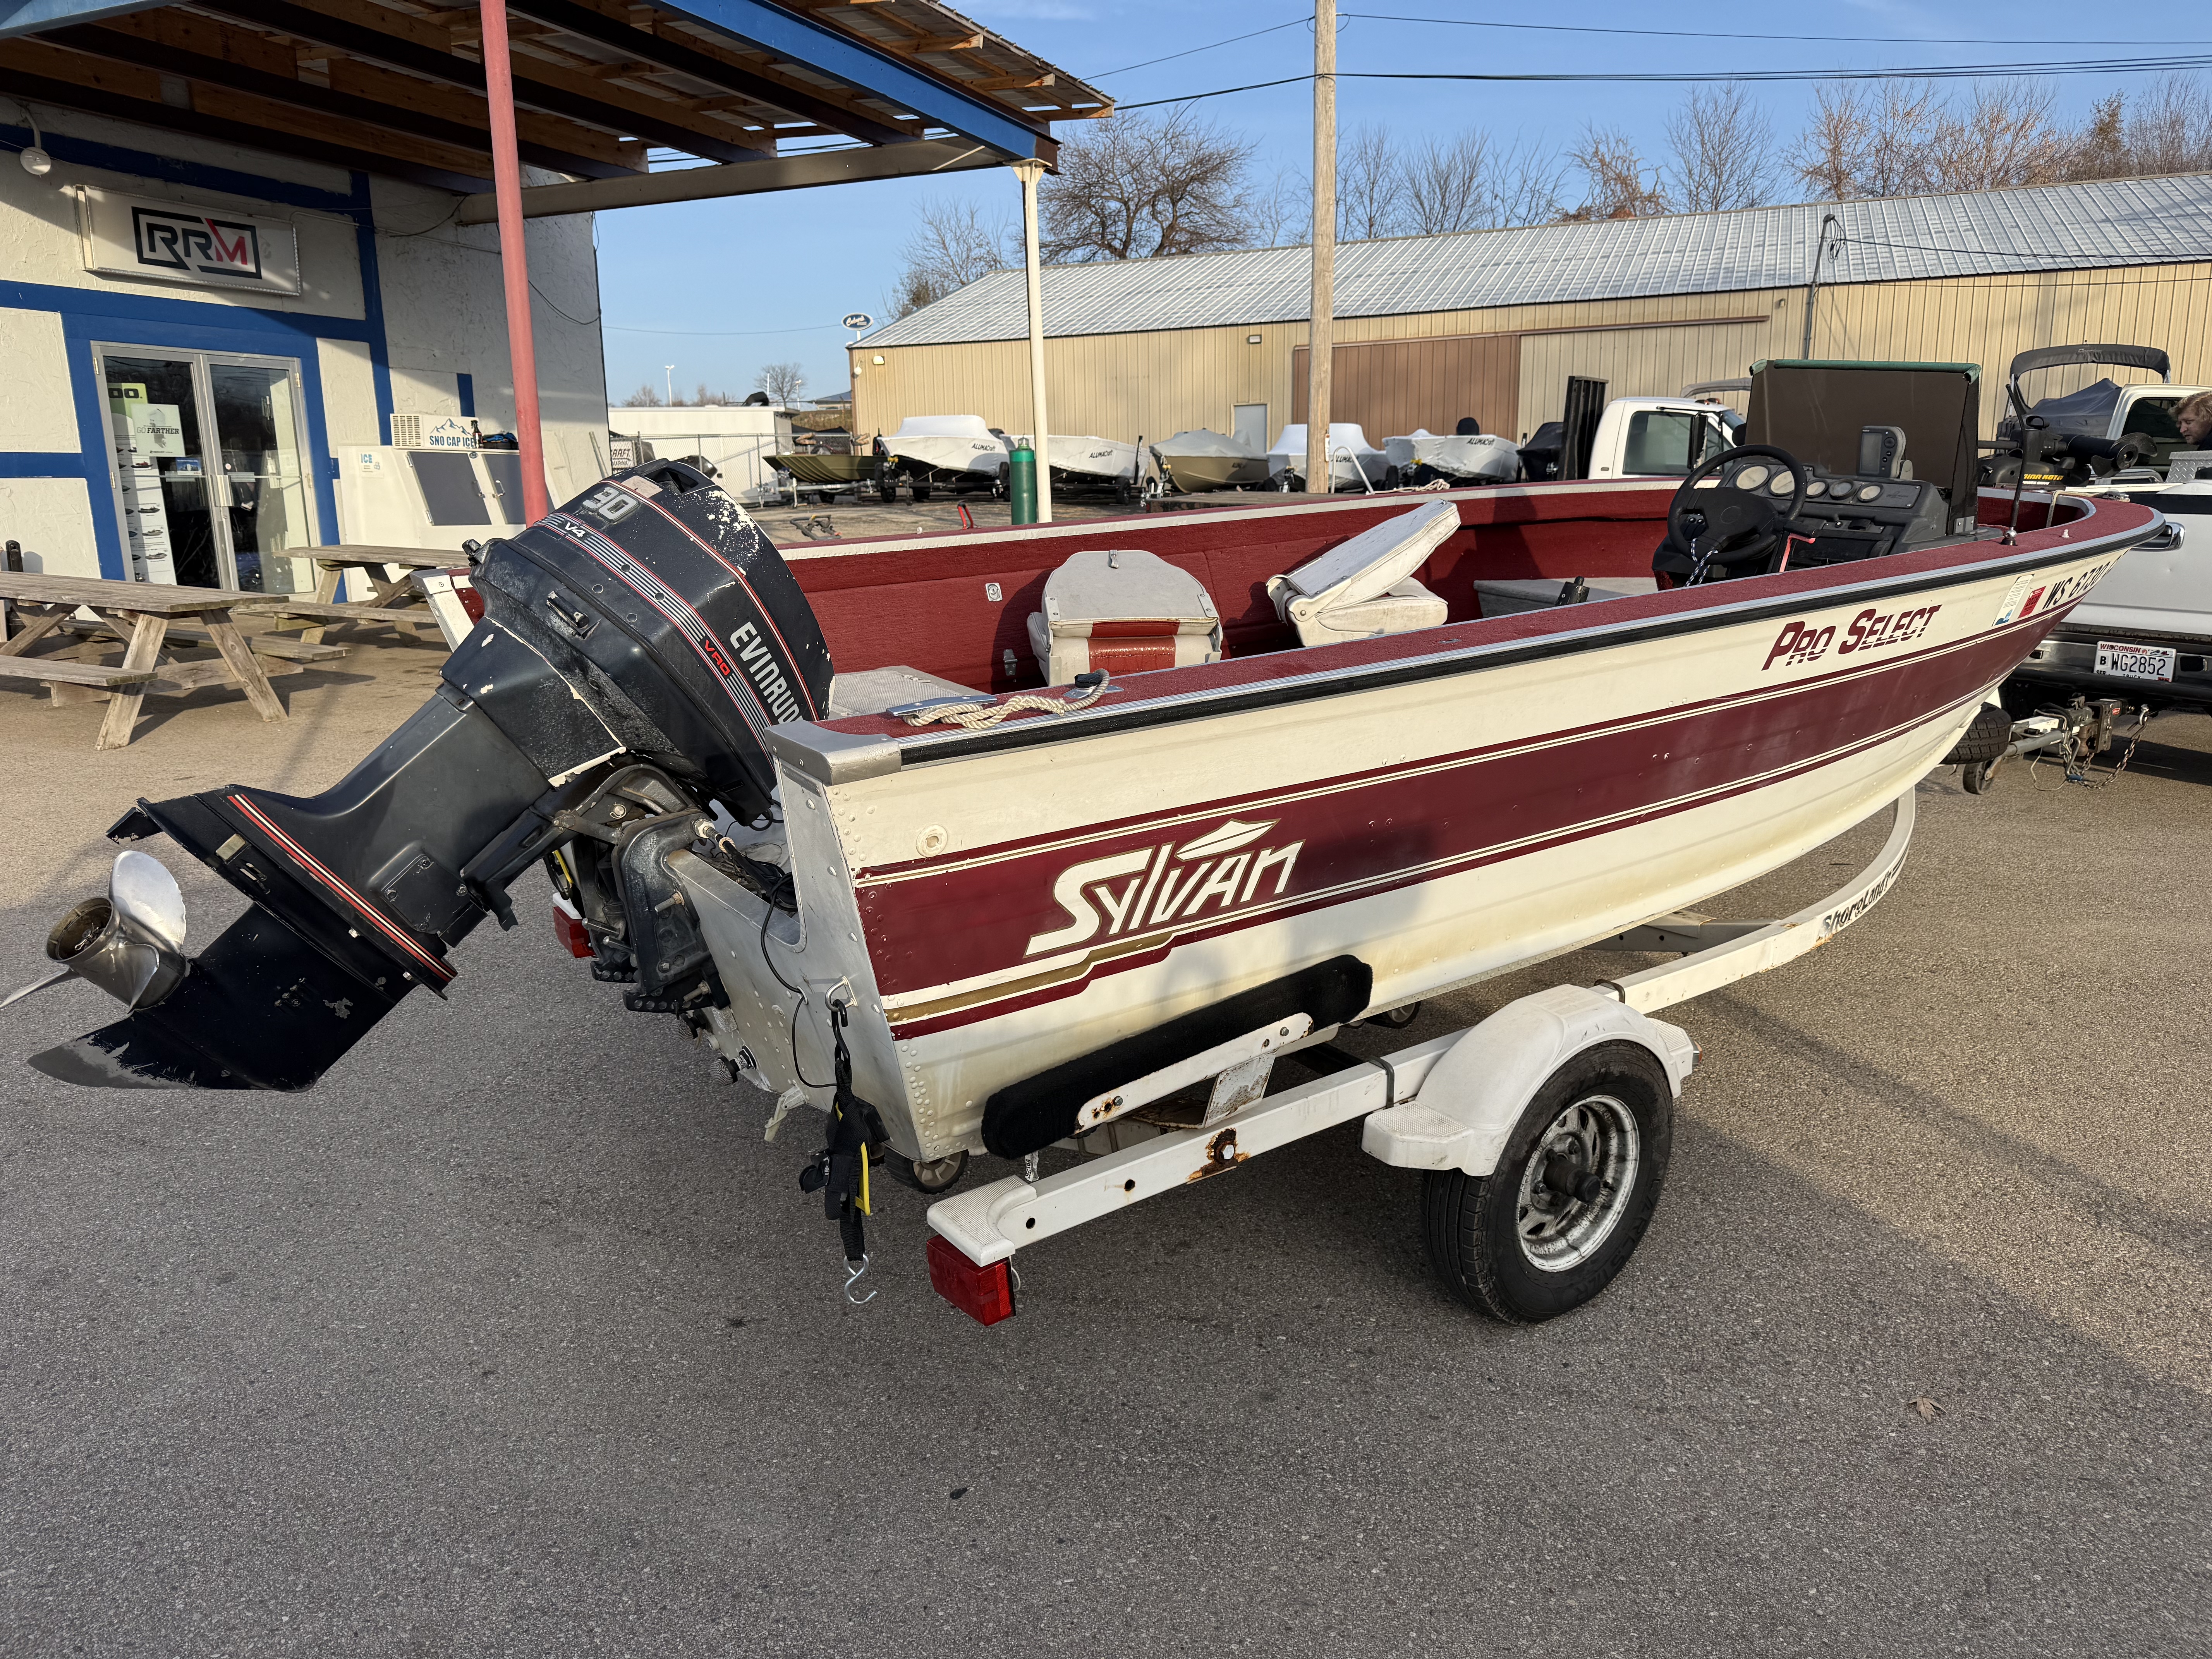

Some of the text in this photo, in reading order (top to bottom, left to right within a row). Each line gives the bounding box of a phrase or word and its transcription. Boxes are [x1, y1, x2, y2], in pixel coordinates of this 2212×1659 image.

[146, 218, 248, 265] RRM
[429, 435, 475, 447] SNO CAP ICE
[565, 522, 586, 538] V4
[2042, 577, 2073, 610] WS
[2100, 643, 2141, 653] WISCONSIN
[730, 621, 804, 724] EVINRUD
[2100, 653, 2166, 676] B WG2852
